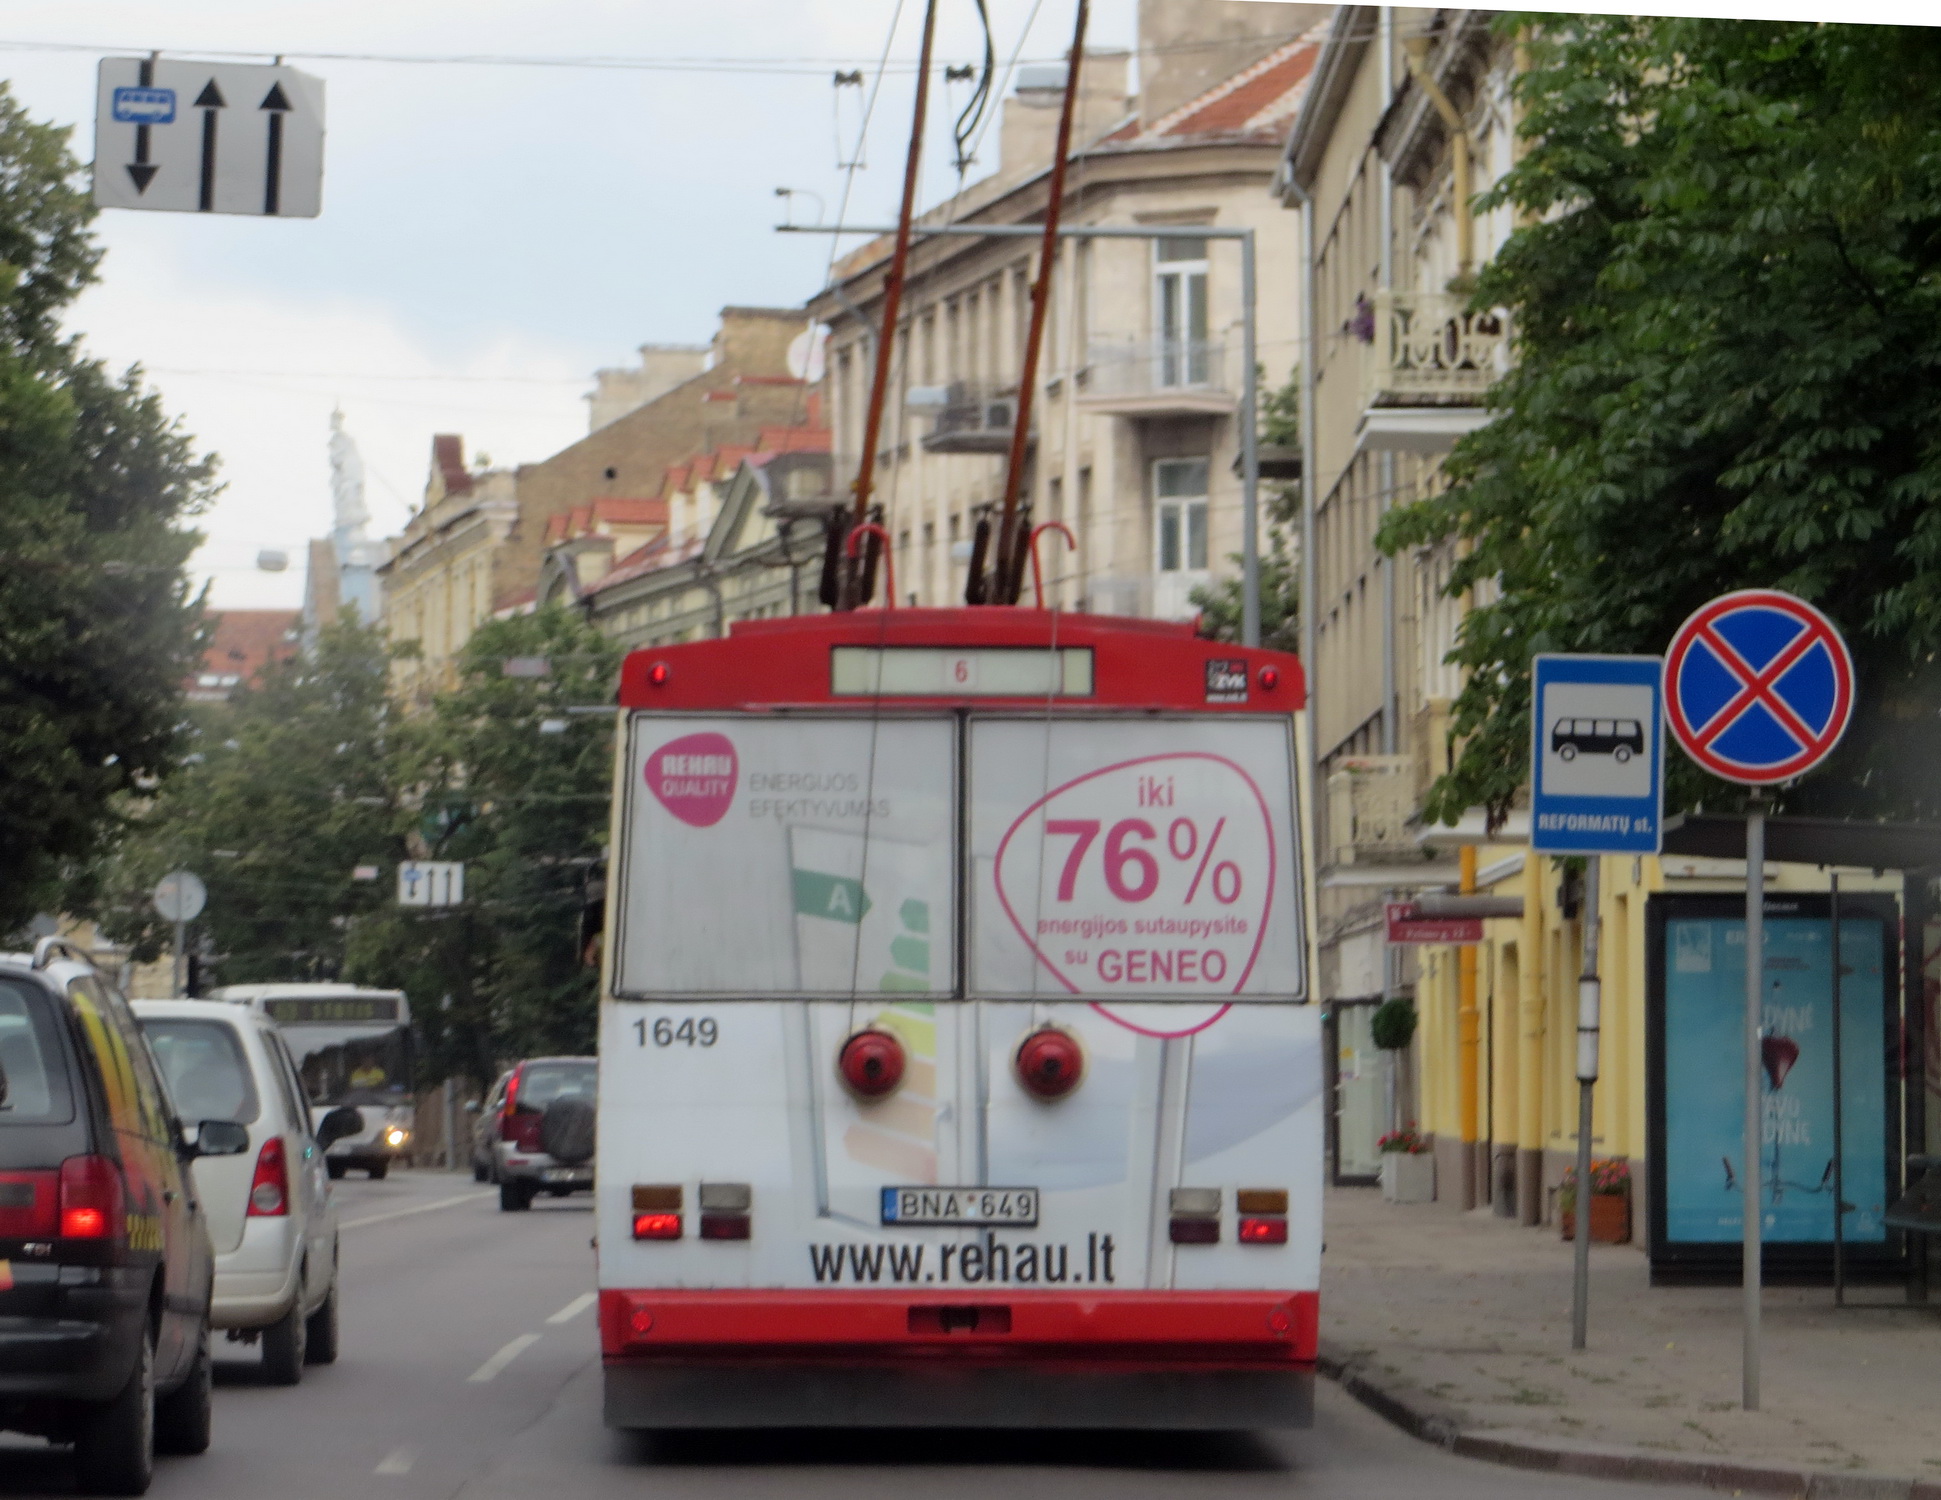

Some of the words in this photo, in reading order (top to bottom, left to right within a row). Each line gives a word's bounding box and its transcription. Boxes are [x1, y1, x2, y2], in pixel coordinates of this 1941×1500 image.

[954, 660, 969, 684] 6
[661, 779, 730, 798] QUALITY
[750, 772, 859, 793] ENERGIJOS
[1138, 776, 1175, 807] iki
[1538, 812, 1631, 838] REFORMATŲ
[1634, 817, 1653, 834] st.
[1045, 816, 1243, 905] 76%
[828, 883, 852, 916] A
[1037, 916, 1128, 939] energijos
[1134, 915, 1248, 939] sutaupysite
[1064, 950, 1088, 965] su
[1097, 949, 1227, 983] GENEO
[632, 1016, 719, 1048] 1649
[901, 1193, 959, 1217] BNA
[981, 1193, 1031, 1217] 649
[810, 1232, 1116, 1283] www.rehau.lt
